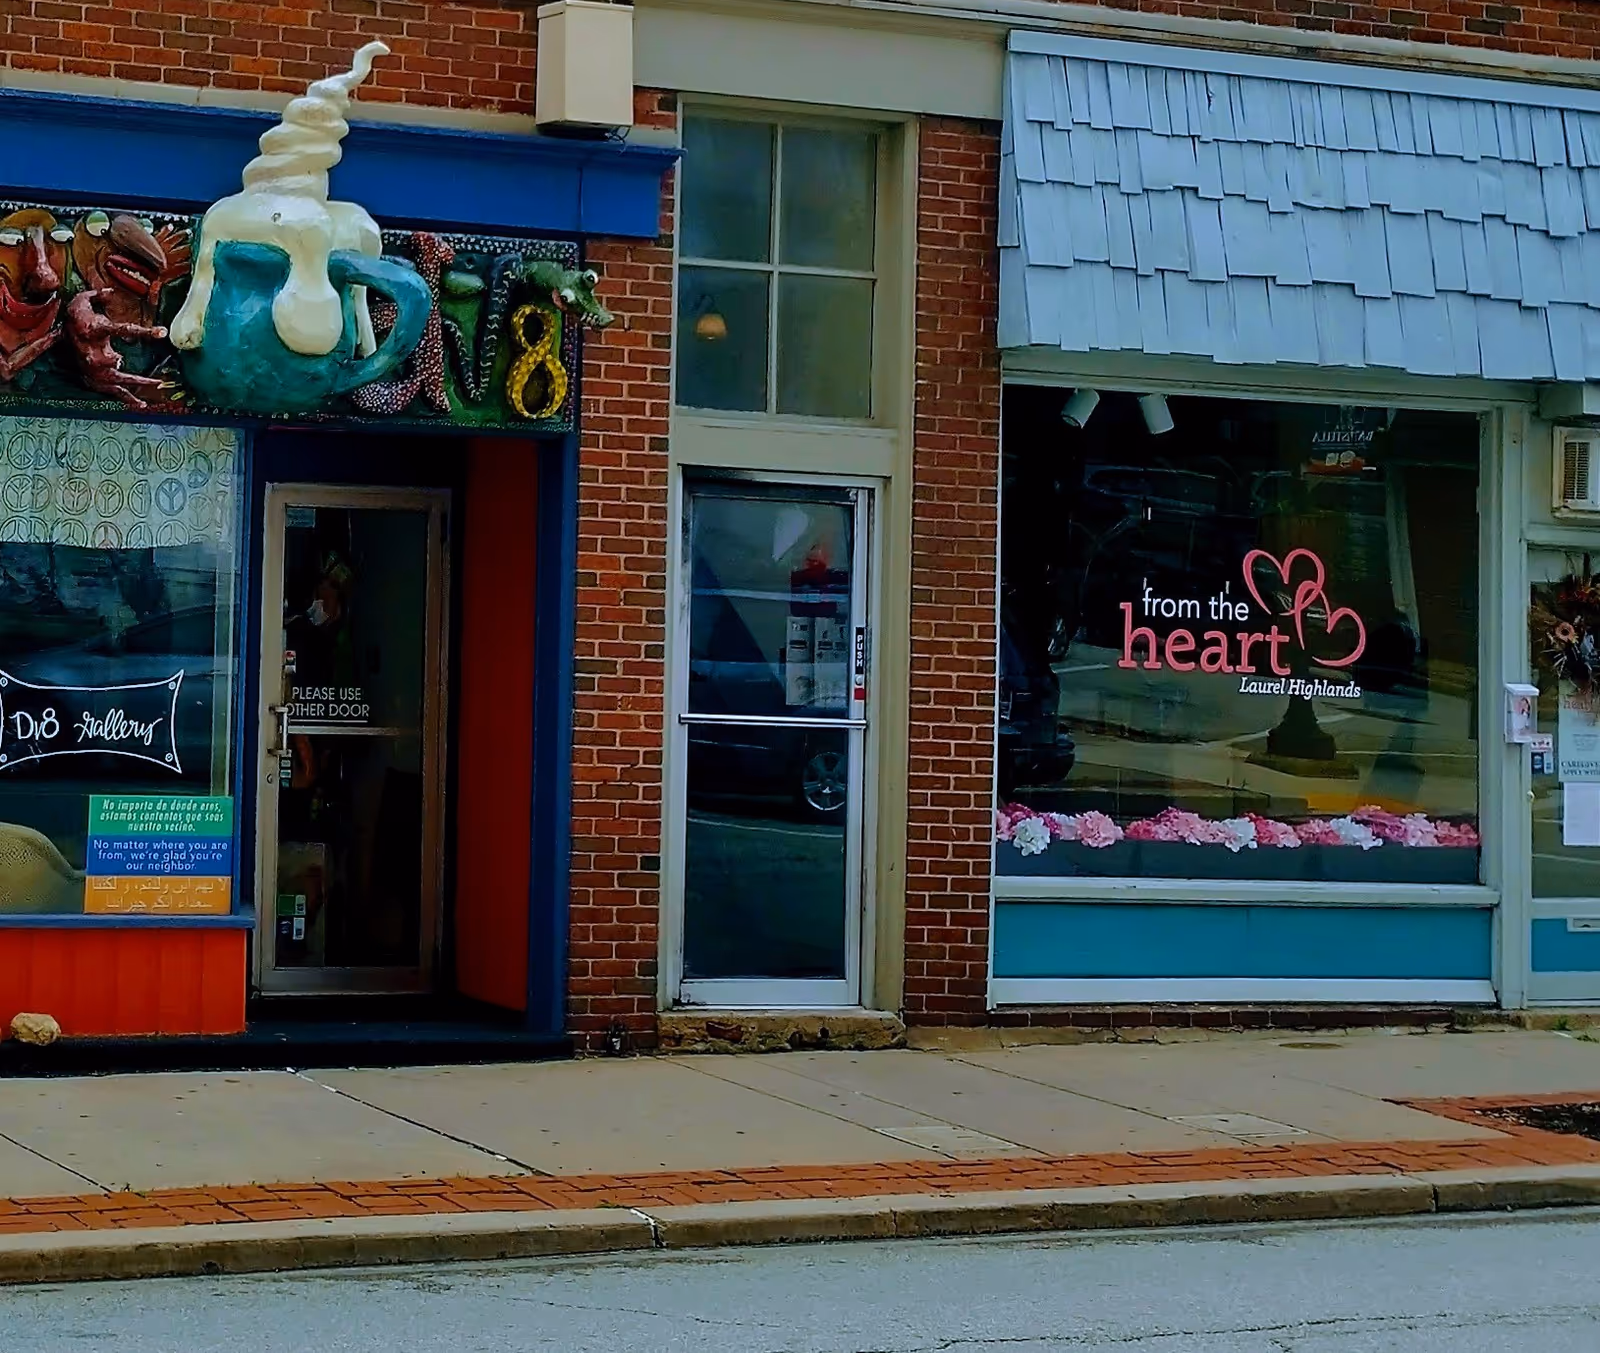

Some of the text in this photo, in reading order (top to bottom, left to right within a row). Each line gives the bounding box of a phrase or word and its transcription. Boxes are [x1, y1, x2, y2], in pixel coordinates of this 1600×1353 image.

[1142, 587, 1249, 621] from the
[1117, 602, 1292, 676] heart
[856, 634, 864, 667] PUSH
[292, 687, 361, 700] PLEASE USE
[1239, 677, 1361, 699] Laurel Highlands
[285, 703, 370, 717] OTHER DOOR
[102, 798, 115, 810] No
[117, 800, 153, 813] importa
[100, 812, 224, 823] estamos contentos que seas
[127, 821, 196, 832] nuestro vecino.
[93, 839, 228, 852] No matter where you are
[97, 849, 223, 863] from, we're glad you're
[125, 860, 197, 873] our neighbor.
